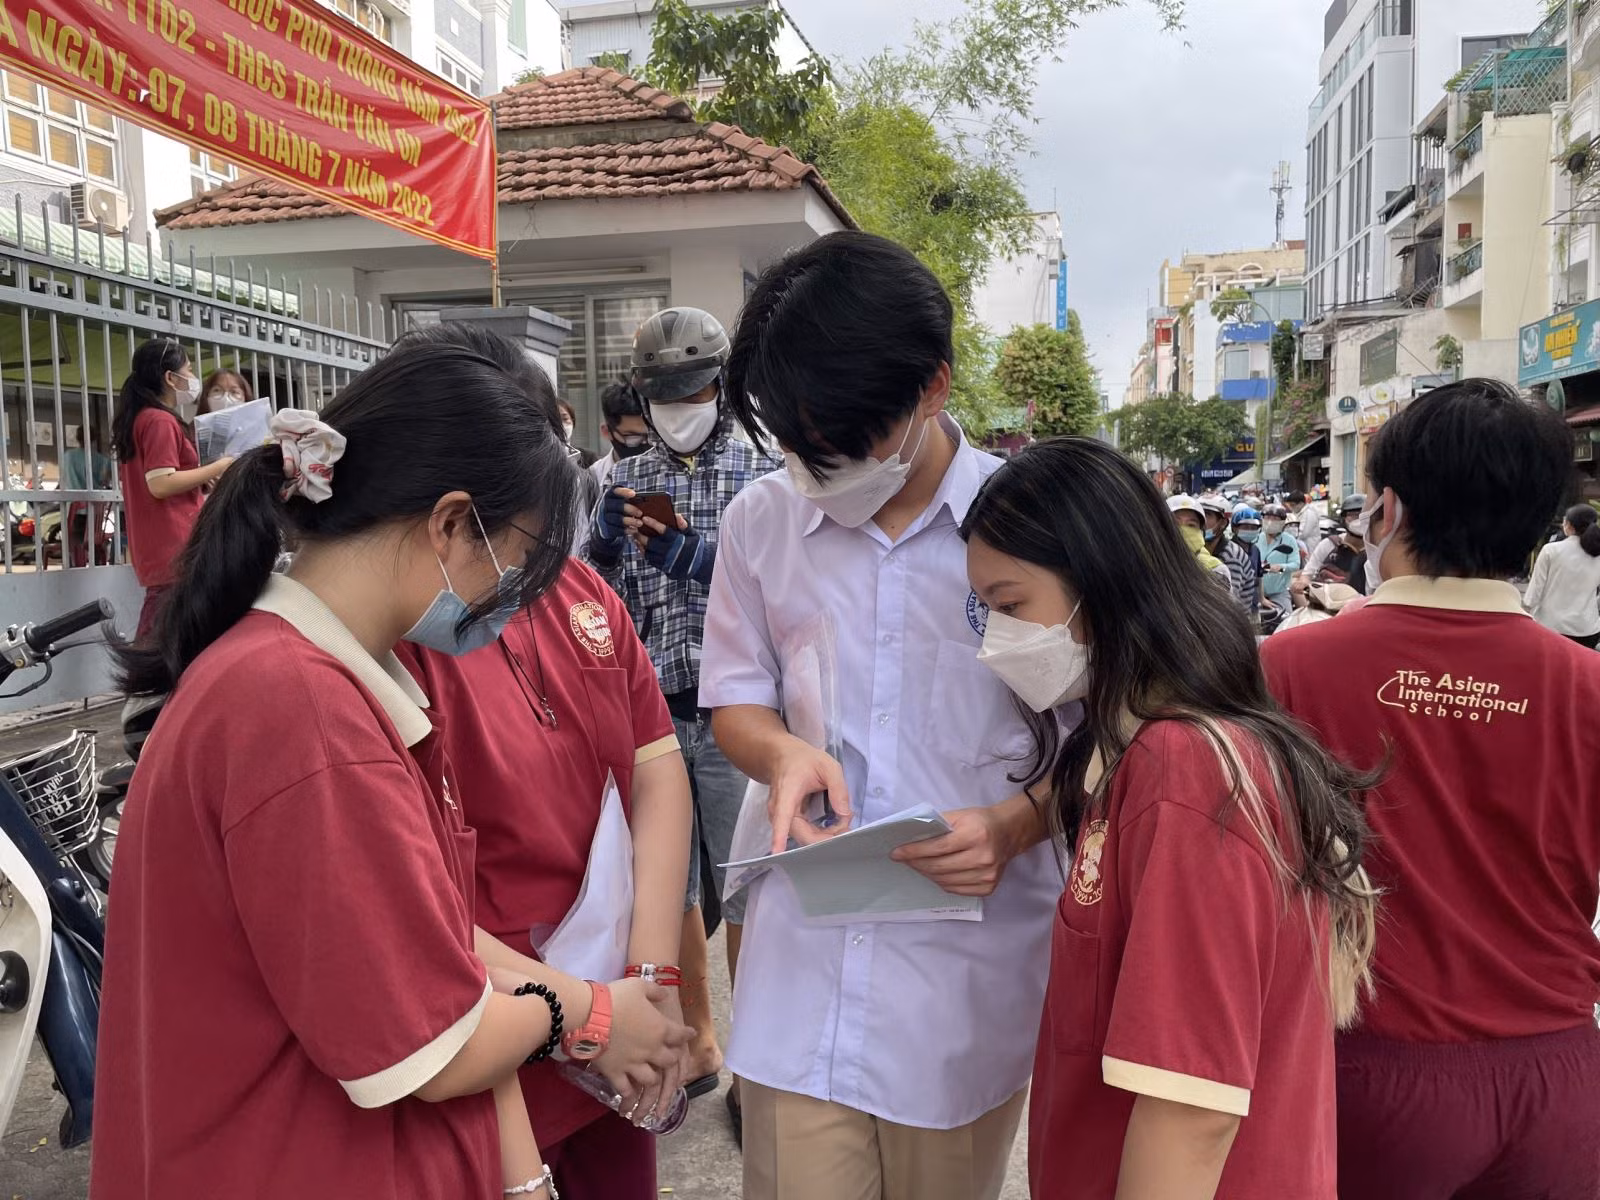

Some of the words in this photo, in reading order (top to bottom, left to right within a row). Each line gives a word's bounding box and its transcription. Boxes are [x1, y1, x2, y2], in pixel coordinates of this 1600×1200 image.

[222, 31, 287, 100] THCS
[293, 69, 349, 134] TRẦN
[353, 103, 395, 155] VĂN
[337, 35, 400, 103] THÔNG
[401, 77, 440, 128] NĂM
[444, 103, 479, 147] 2022
[204, 92, 238, 141] 08
[244, 109, 322, 180] THÁNG
[327, 149, 342, 187] 7
[343, 157, 389, 209] NĂM
[392, 182, 436, 226] 2022
[968, 591, 977, 613] ASIA
[1396, 670, 1431, 687] The
[1435, 673, 1500, 695] Asian
[1398, 685, 1529, 715] International
[1408, 702, 1492, 723] School
